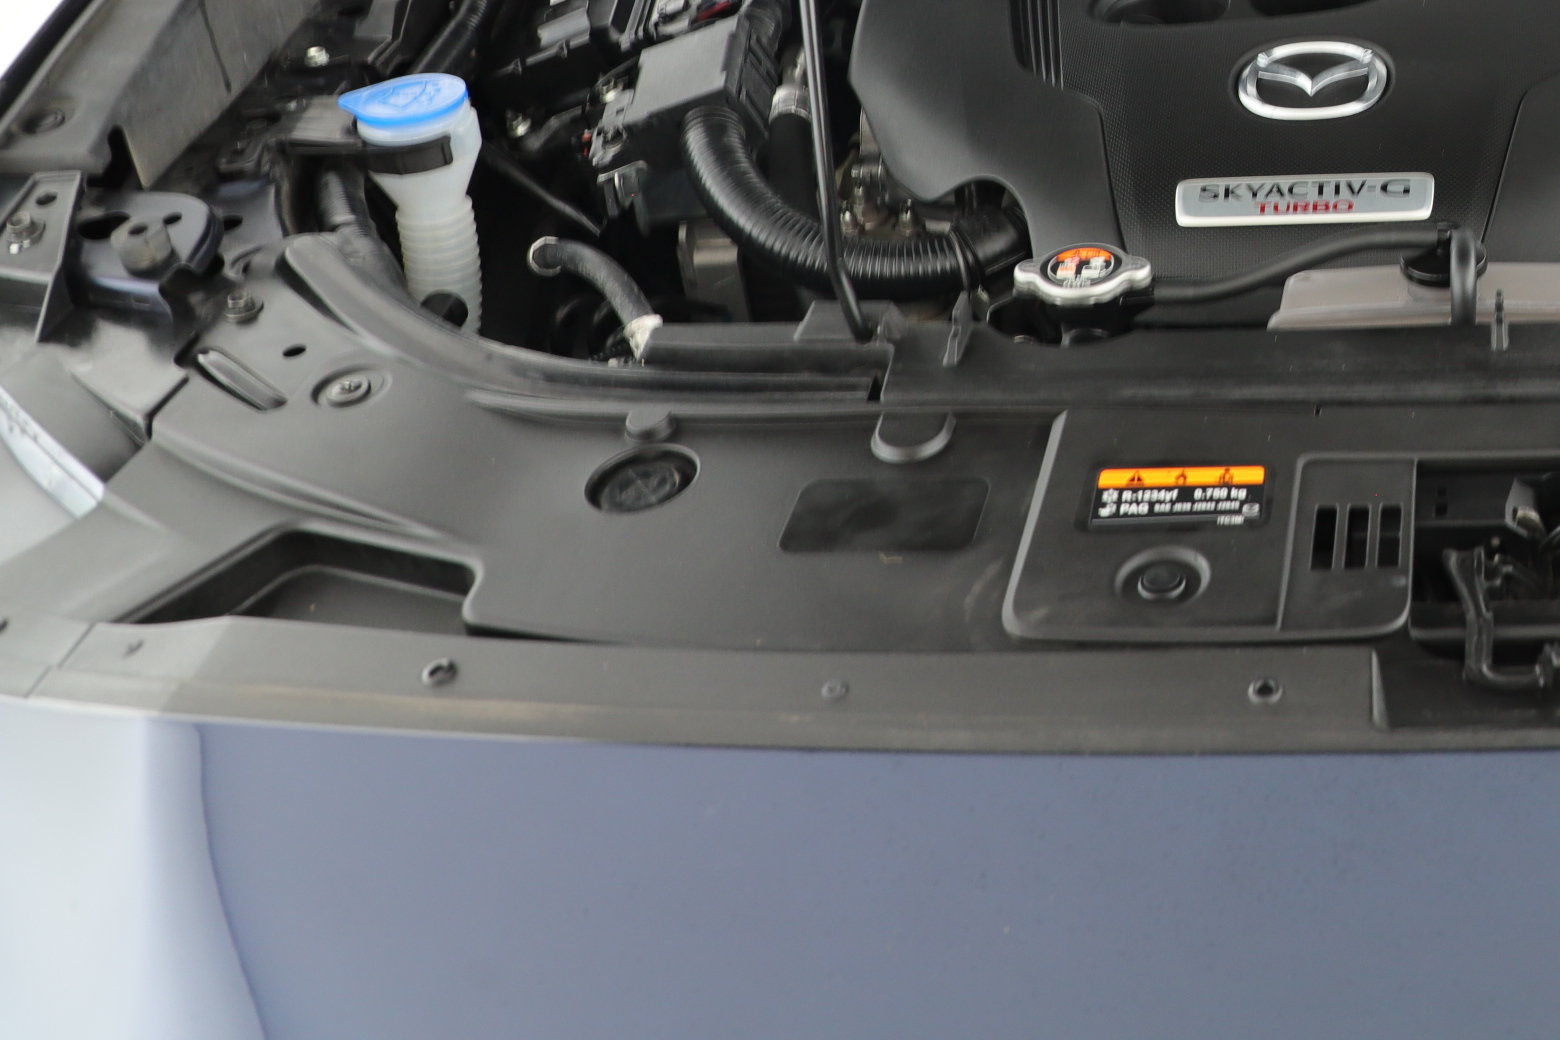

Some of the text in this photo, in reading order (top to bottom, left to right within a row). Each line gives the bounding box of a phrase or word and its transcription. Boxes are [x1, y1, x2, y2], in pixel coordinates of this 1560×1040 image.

[1198, 179, 1411, 203] SKYACTIV-G
[1254, 199, 1354, 215] TURBO
[1119, 502, 1149, 516] PAG
